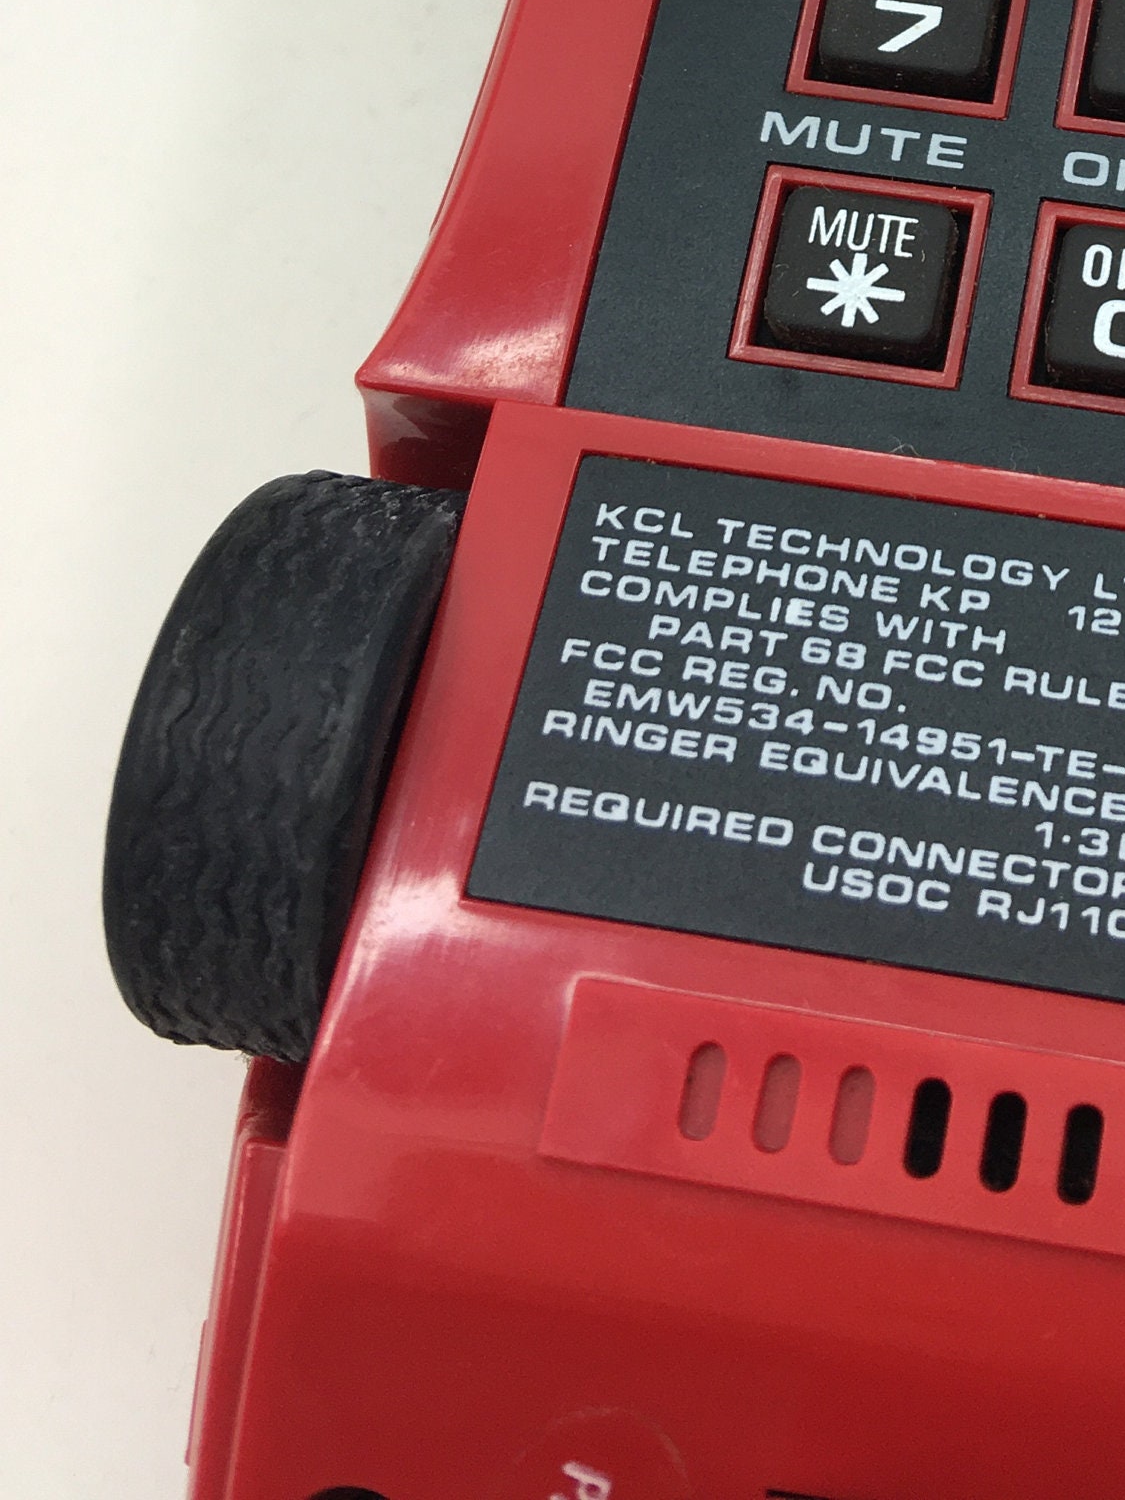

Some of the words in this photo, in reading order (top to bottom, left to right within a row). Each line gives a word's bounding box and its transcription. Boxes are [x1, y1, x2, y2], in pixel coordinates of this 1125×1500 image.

[759, 110, 968, 170] MUTE
[807, 205, 919, 258] MUTE
[591, 535, 901, 604] TELEPHONE
[919, 583, 991, 614] KP
[595, 503, 694, 539] KCL
[716, 518, 1070, 591] TECHNOLOGY
[580, 569, 850, 633] COMPLIES
[875, 610, 1007, 655] WITH
[560, 638, 664, 677] FCC
[681, 655, 799, 697] REG.
[815, 675, 907, 713] NO.
[648, 614, 789, 658] PART
[800, 636, 867, 671] 68
[882, 649, 985, 688] FCC
[542, 709, 738, 763] RINGER
[523, 781, 794, 847] REQUIRED
[802, 861, 951, 912] USOC
